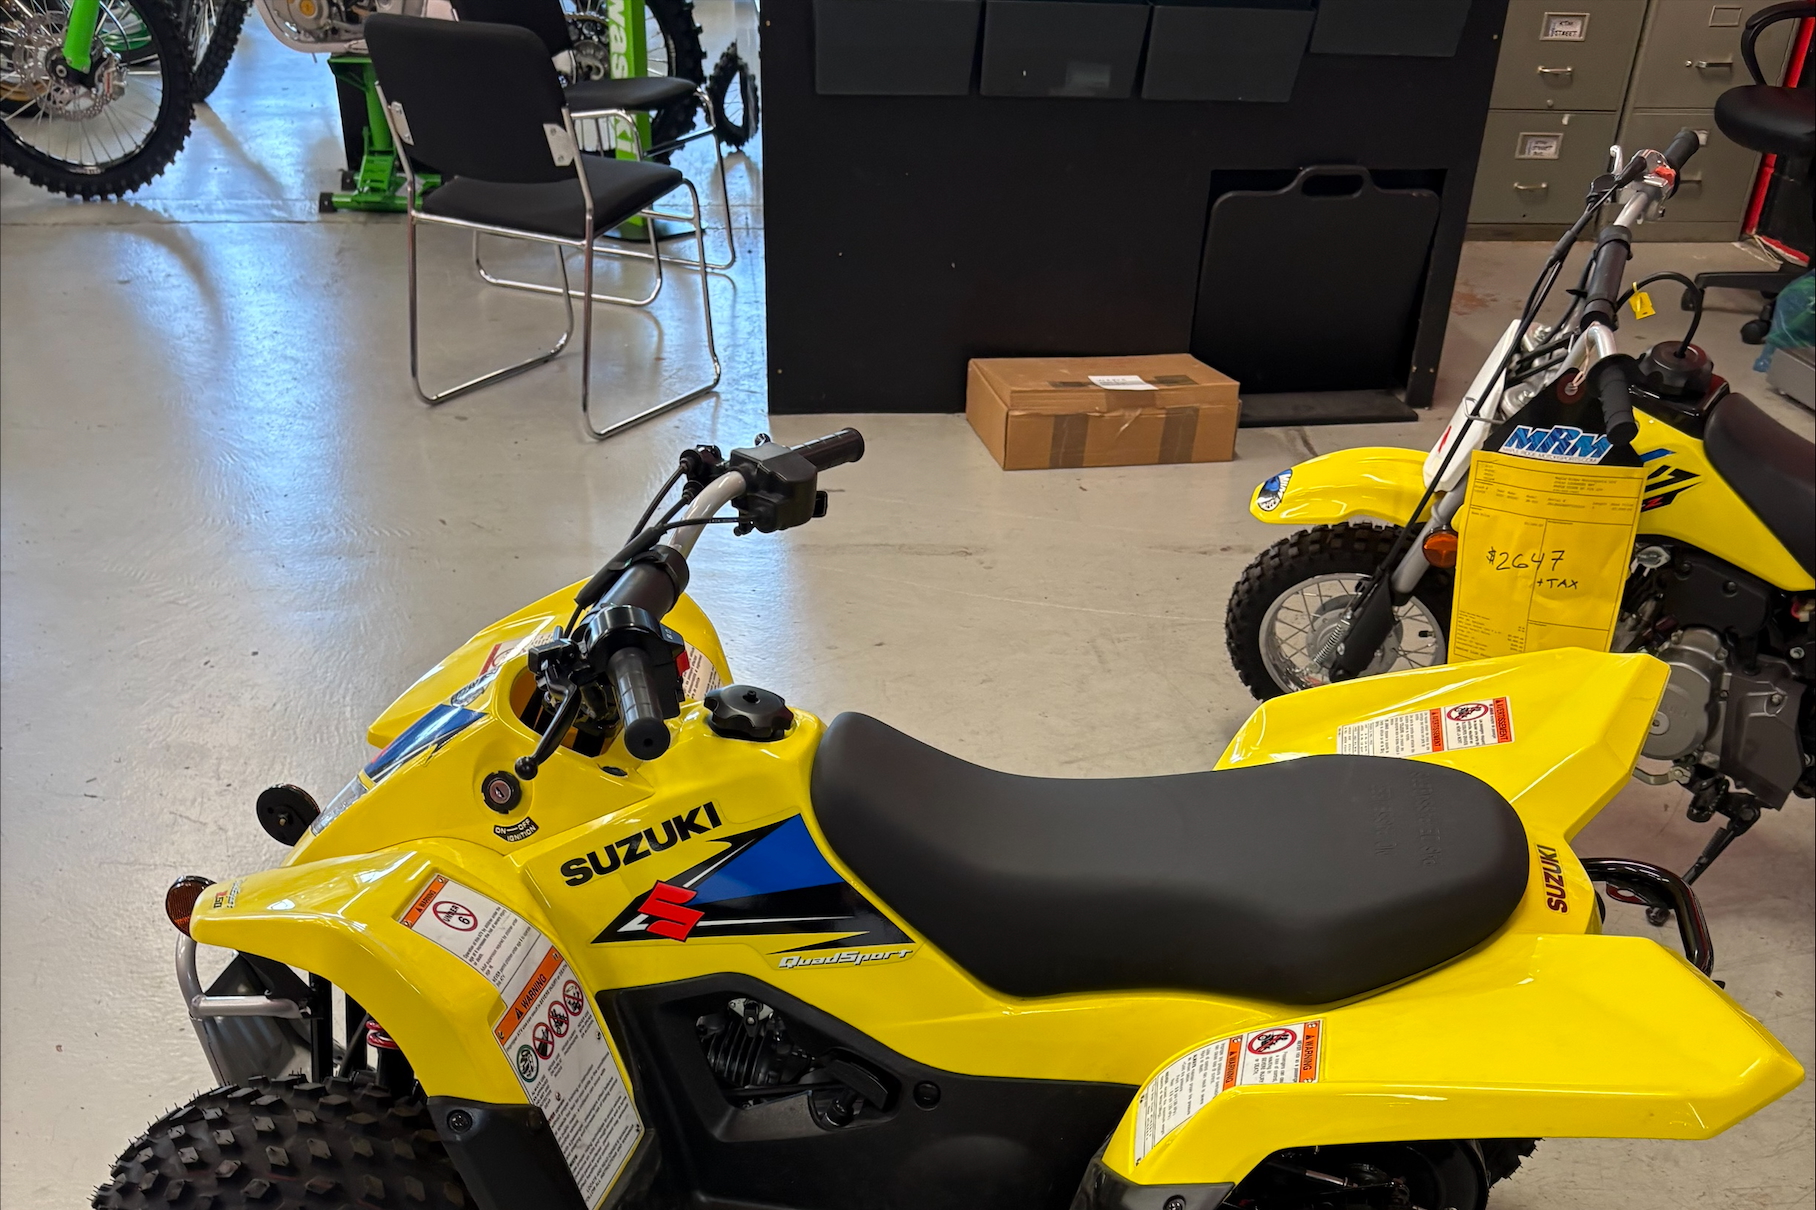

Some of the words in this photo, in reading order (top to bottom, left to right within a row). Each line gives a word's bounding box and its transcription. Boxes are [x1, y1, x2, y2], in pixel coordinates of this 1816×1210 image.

[1504, 427, 1612, 458] MRM
[1486, 546, 1565, 571] $2647
[507, 825, 537, 842] IGNITION
[560, 801, 723, 887] SUZUKI
[1536, 844, 1568, 913] SUZUKI
[421, 889, 437, 907] WARNING
[443, 904, 460, 923] UNDER
[458, 915, 471, 926] 6
[778, 948, 913, 969] QuadSport
[520, 973, 547, 1009] WARNING
[1301, 1040, 1312, 1072] WARNING
[1225, 1057, 1234, 1084] WARNING
